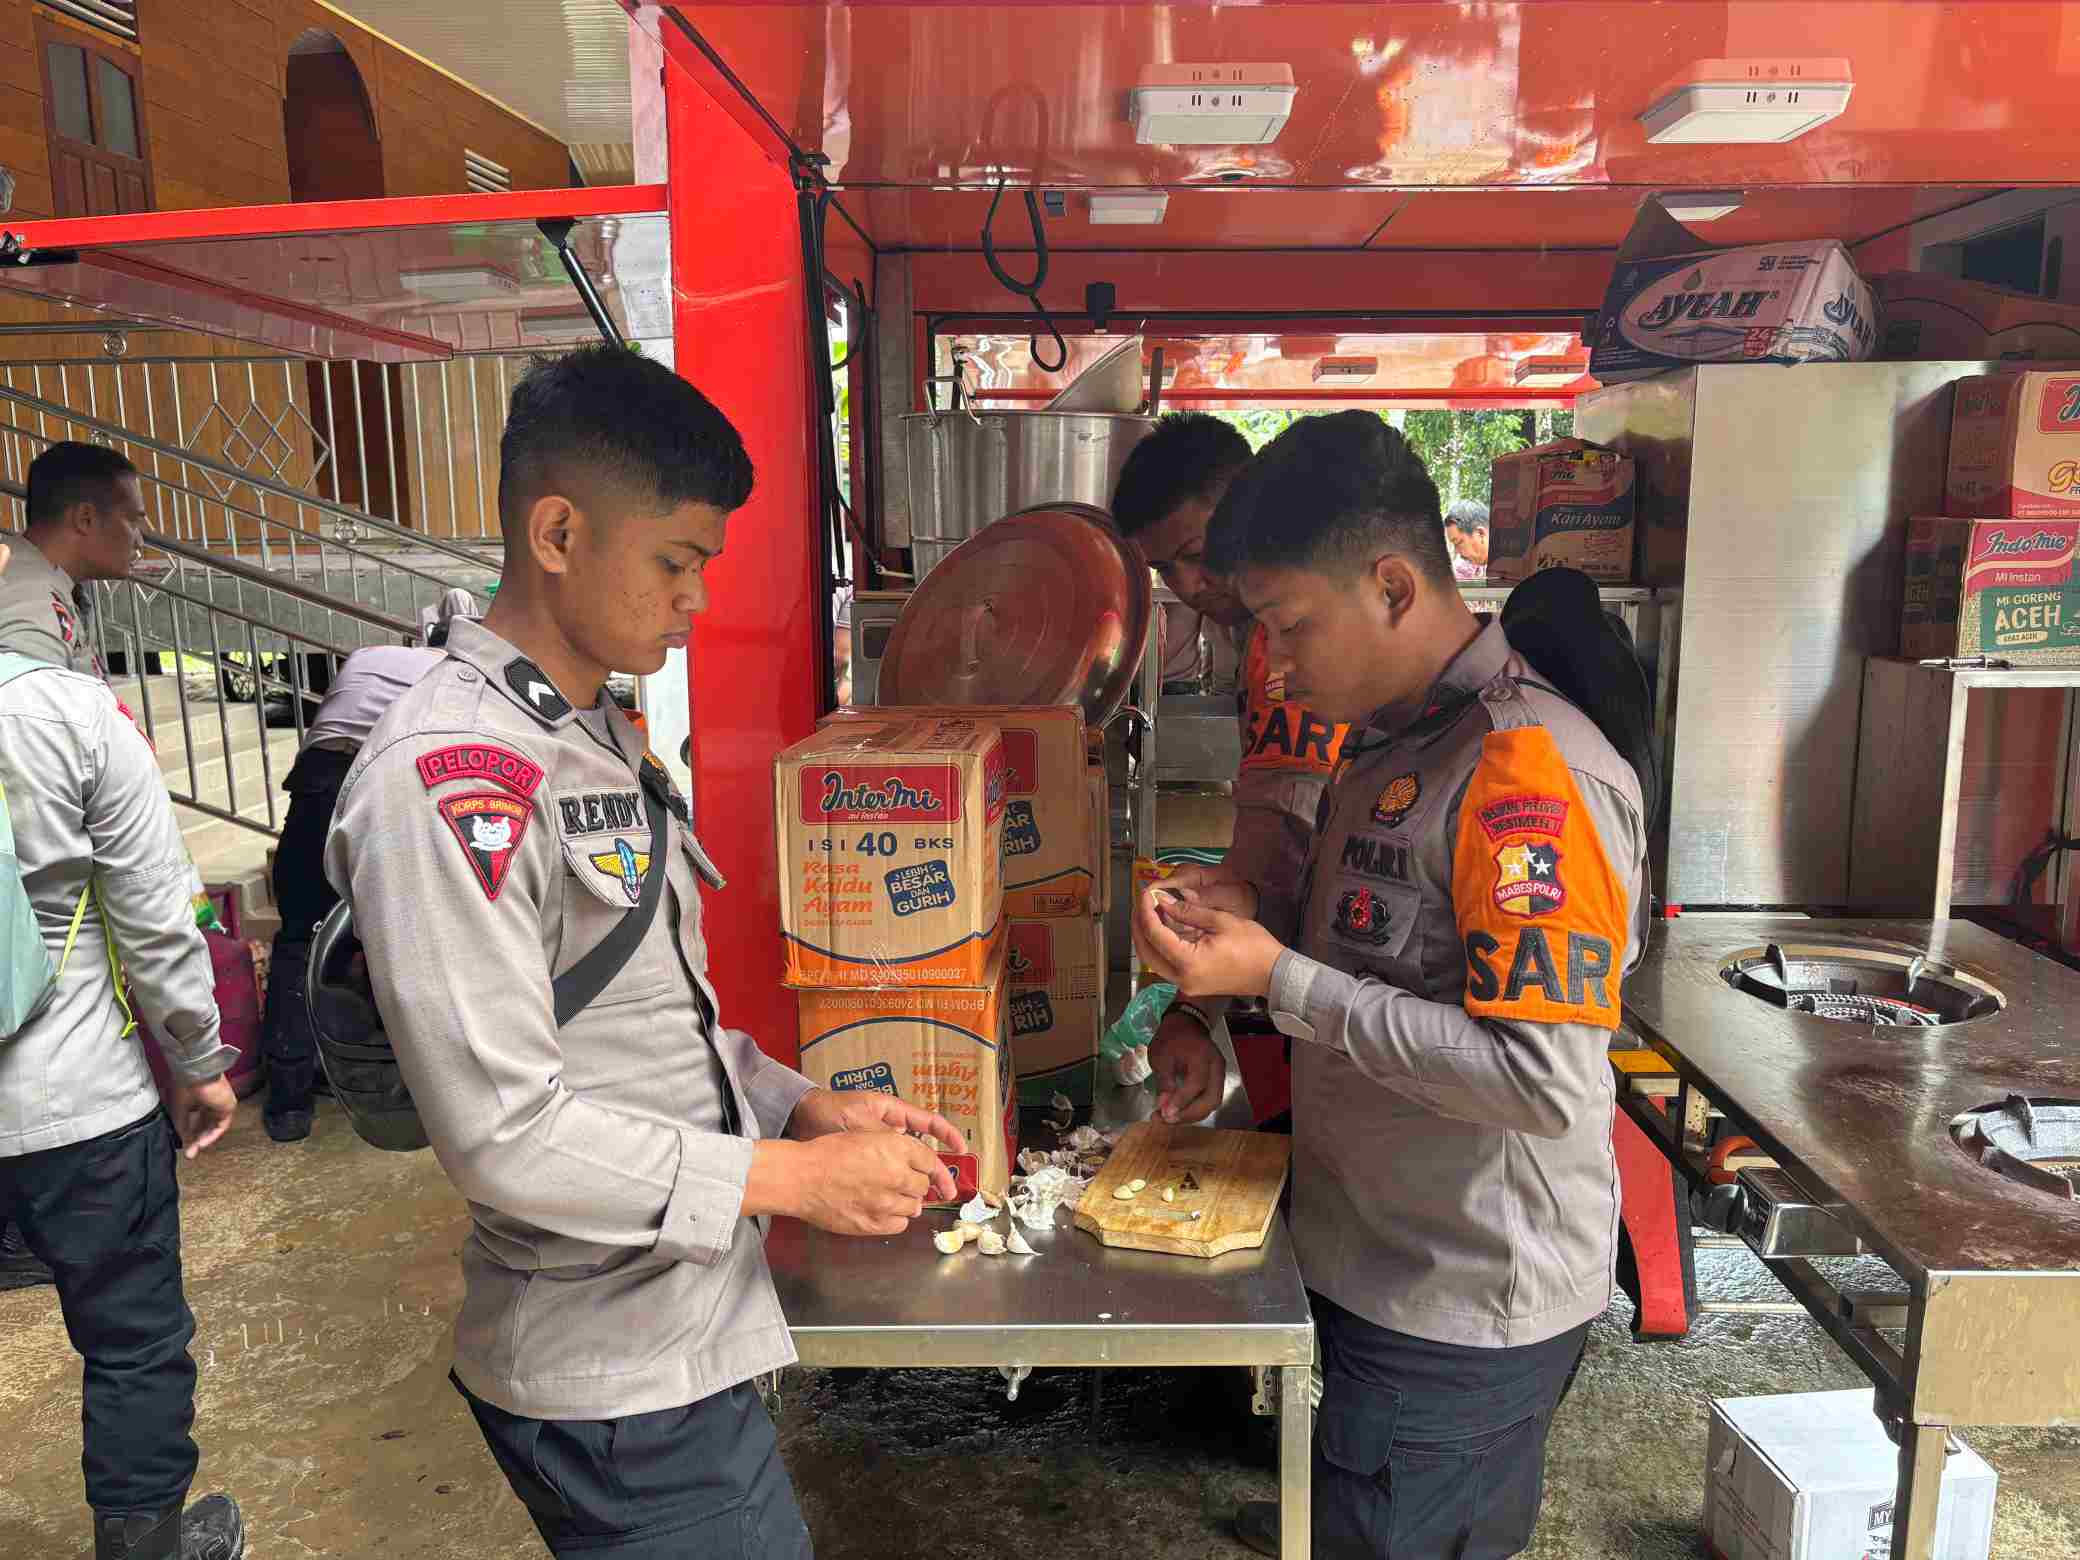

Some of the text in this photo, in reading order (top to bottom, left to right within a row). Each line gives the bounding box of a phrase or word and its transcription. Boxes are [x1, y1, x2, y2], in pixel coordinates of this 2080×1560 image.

[2014, 591, 2061, 605] GORENG
[1995, 605, 2061, 632] ACEH
[428, 749, 534, 789] PELOPOR
[559, 793, 643, 834] RENDY
[808, 831, 955, 856] ISI 40 BKS
[890, 871, 946, 894] BESAR
[900, 866, 929, 879] LEBIH
[896, 890, 951, 913] GURIH
[911, 886, 930, 898] DAN
[1497, 882, 1562, 899] MABES POLRI
[1465, 928, 1612, 1008] SAR
[835, 1065, 888, 1087] GURIH
